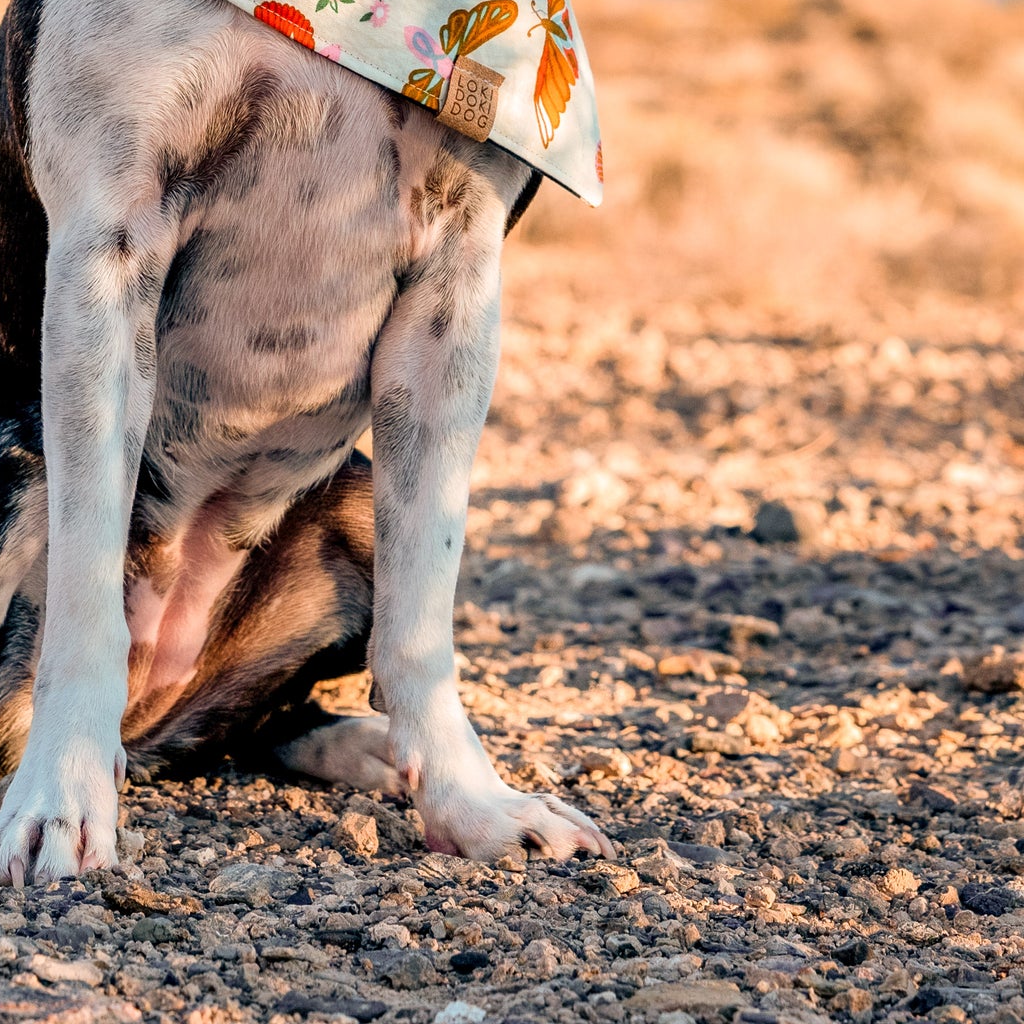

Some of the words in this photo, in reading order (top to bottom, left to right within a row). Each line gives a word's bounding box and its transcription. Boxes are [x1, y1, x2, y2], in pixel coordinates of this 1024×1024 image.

[457, 74, 494, 101] LOKI
[455, 88, 492, 114] DOKI
[450, 102, 489, 128] DOG
